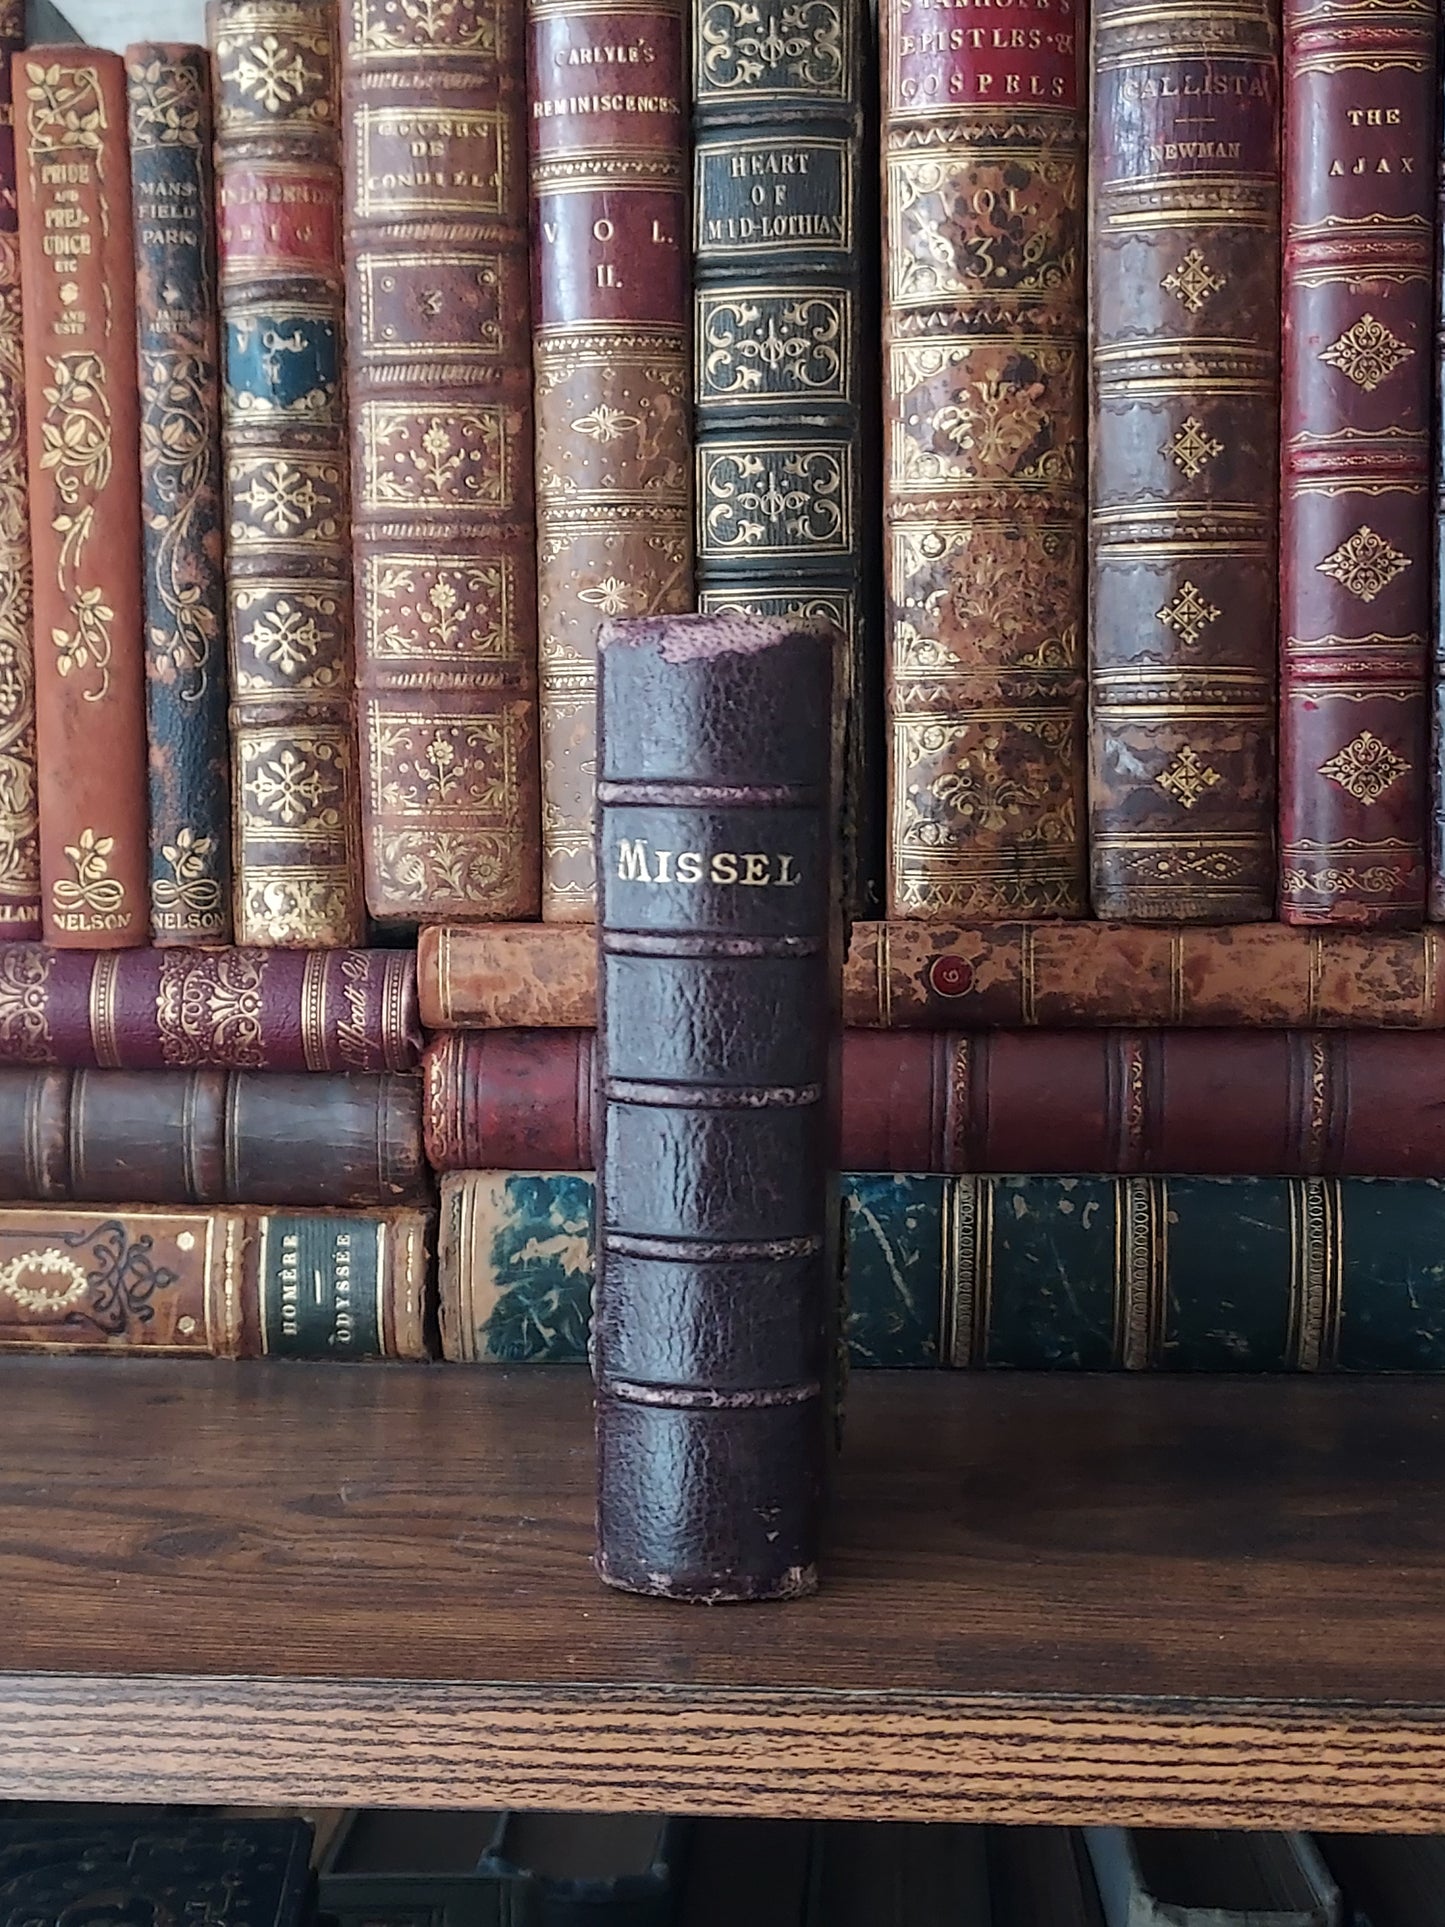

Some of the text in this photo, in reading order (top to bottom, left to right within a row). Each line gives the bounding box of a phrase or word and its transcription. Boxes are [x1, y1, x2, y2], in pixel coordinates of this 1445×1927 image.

[554, 37, 656, 67] CARLYLE'S
[900, 28, 1041, 56] EPISTLES
[900, 72, 1065, 98] GOSPELS
[1123, 75, 1270, 101] CALLISTA
[1347, 108, 1401, 127] THE
[1149, 141, 1241, 162] NEWMAN
[41, 163, 90, 185] PRIDE
[731, 153, 810, 178] HEART
[1329, 157, 1416, 177] AJAX
[54, 189, 80, 203] AND
[751, 183, 788, 207] OF
[138, 203, 196, 219] FIELD
[142, 229, 198, 247] PARK
[708, 214, 844, 241] MID-LOTHIAN
[42, 234, 92, 256] UDICE
[54, 259, 78, 273] ETC
[52, 912, 132, 932] NELSON
[153, 912, 225, 932] NELSON
